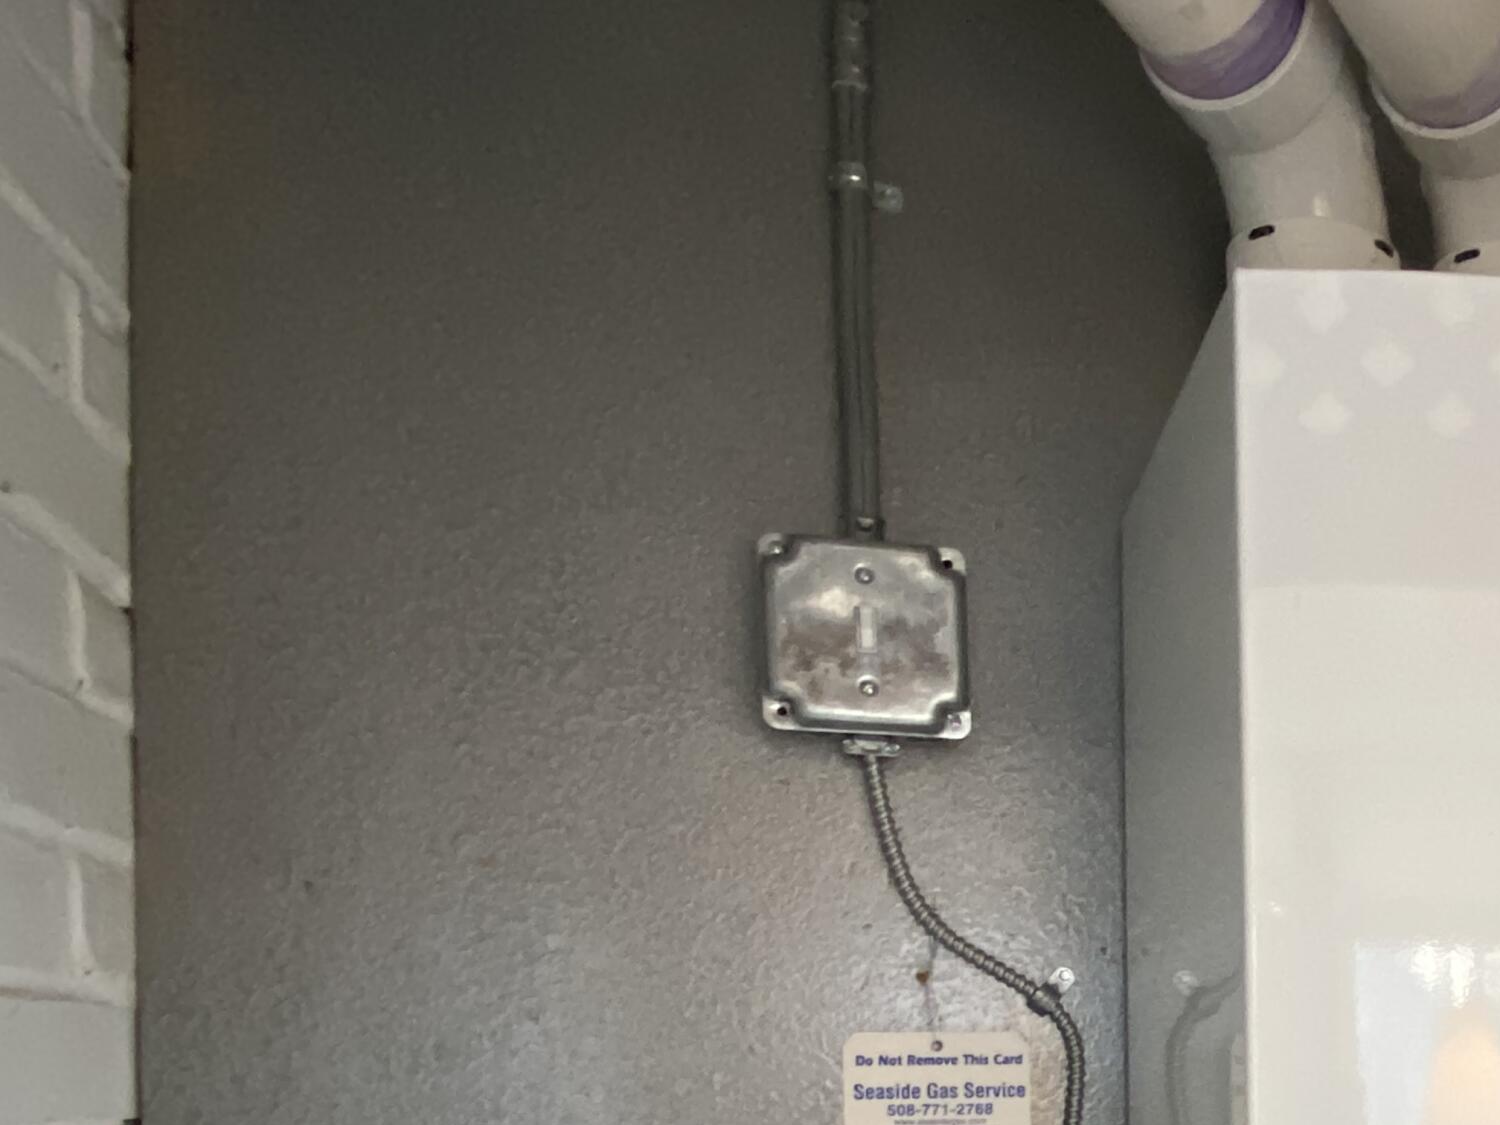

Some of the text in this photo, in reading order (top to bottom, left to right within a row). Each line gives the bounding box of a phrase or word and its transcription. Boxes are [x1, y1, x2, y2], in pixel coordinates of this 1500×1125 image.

[855, 1054, 1023, 1067] Do Not Remove This Card
[853, 1082, 1026, 1100] Seaside Gas Service
[887, 1103, 993, 1117] 508-771-2768
